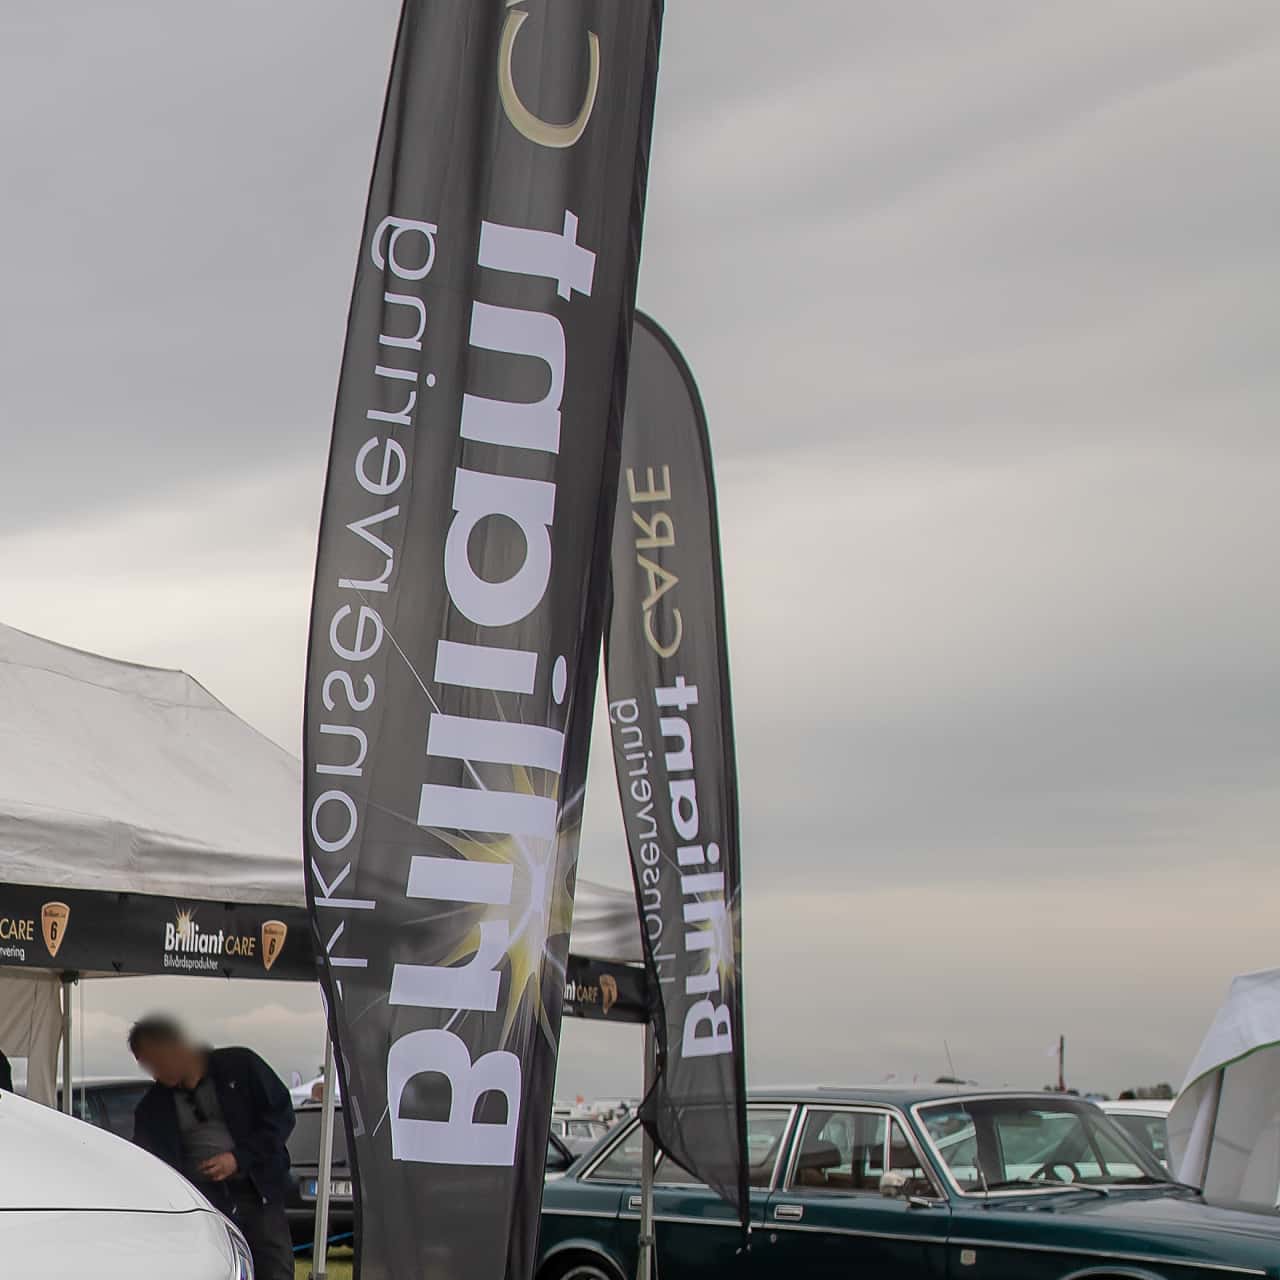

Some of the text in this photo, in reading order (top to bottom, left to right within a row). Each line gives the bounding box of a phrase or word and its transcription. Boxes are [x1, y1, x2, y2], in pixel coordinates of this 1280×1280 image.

[0, 918, 35, 941] CARE
[50, 921, 58, 940] 6
[165, 921, 256, 956] Brilliant CARE
